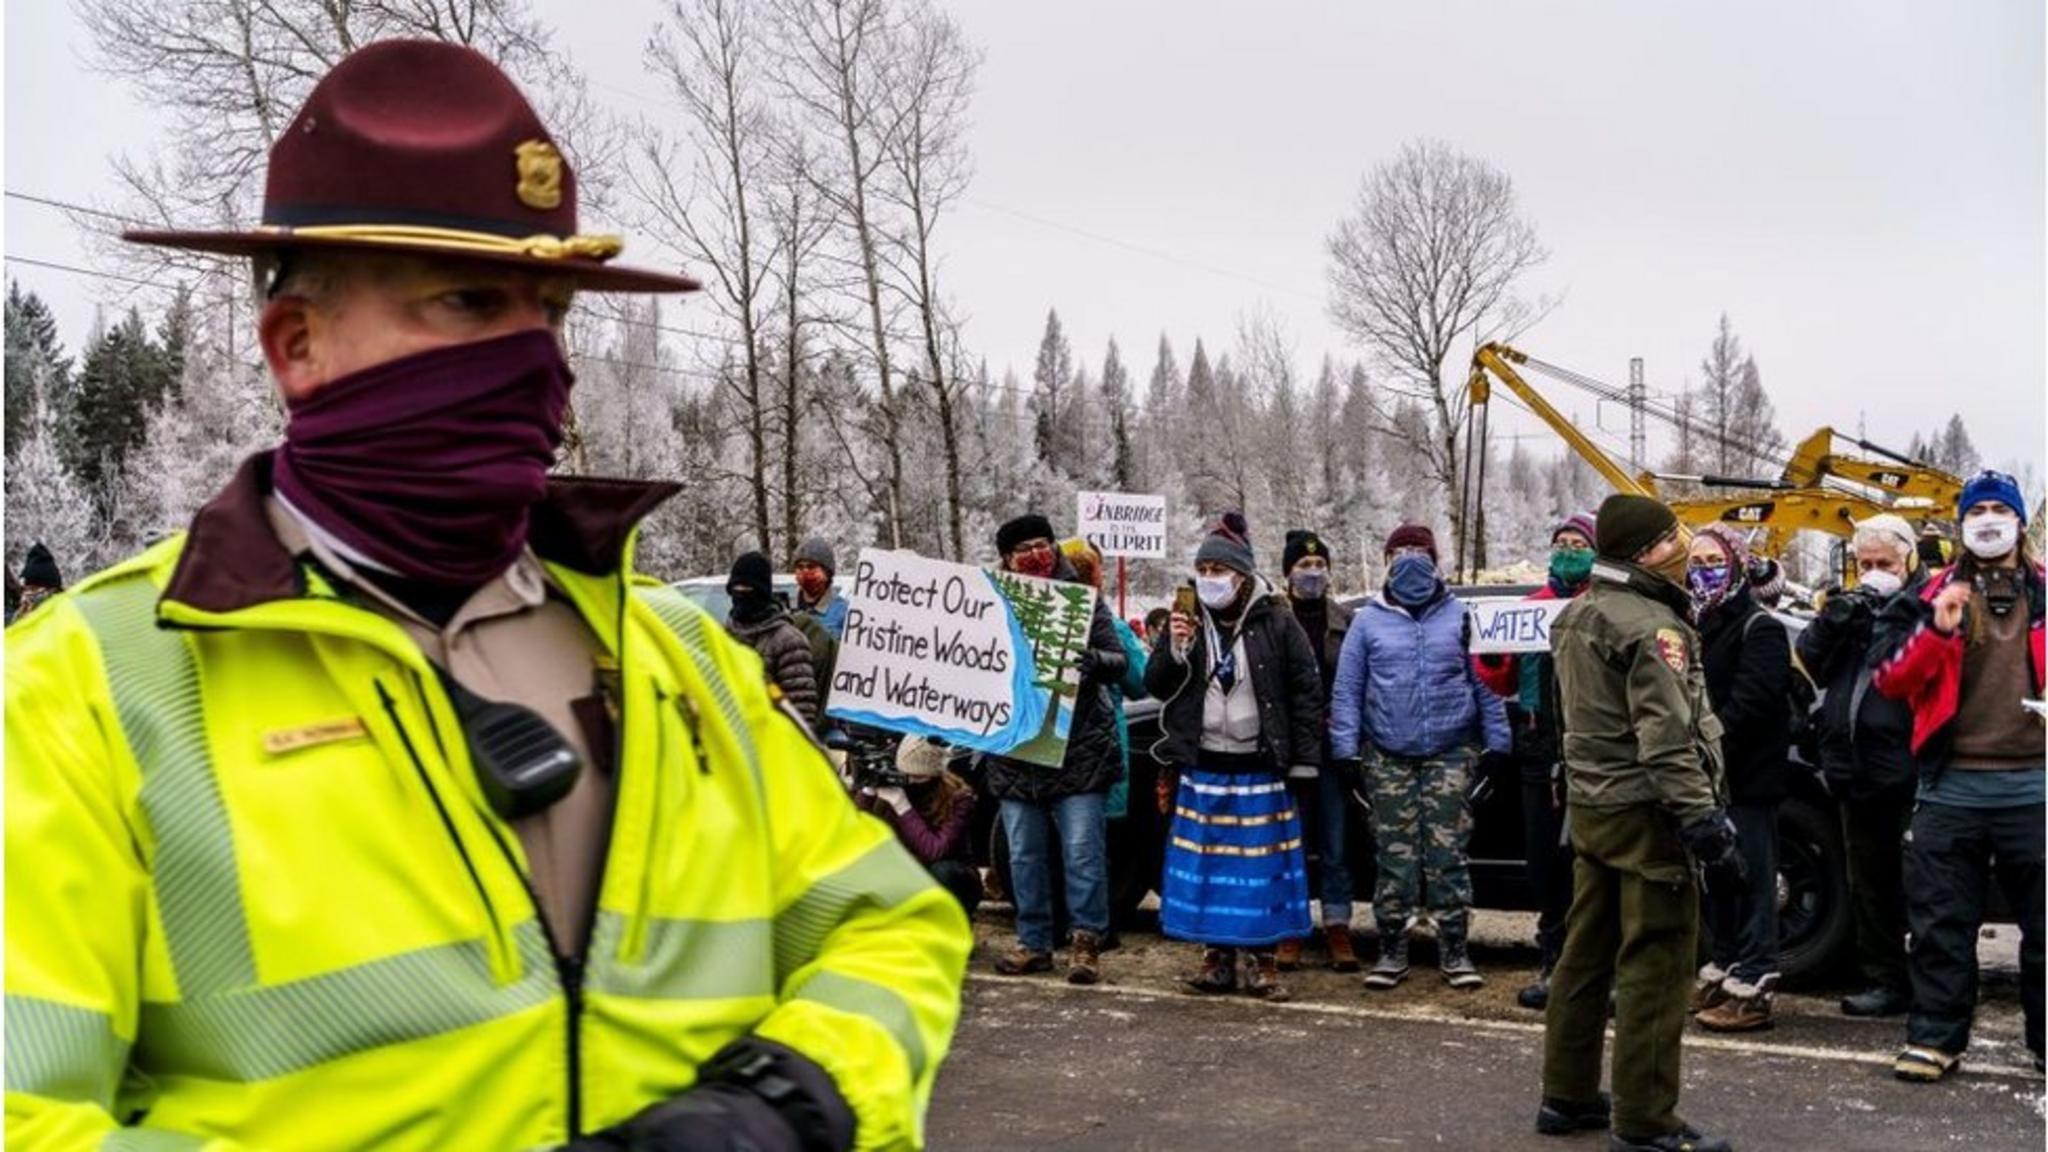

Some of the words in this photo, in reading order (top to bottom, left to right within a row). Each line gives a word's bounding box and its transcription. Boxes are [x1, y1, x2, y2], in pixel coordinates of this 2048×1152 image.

[1738, 507, 1762, 521] CAT
[853, 562, 937, 609] Protect
[943, 576, 994, 620] Our
[844, 609, 928, 660] Pristine
[934, 626, 1008, 672] Woods
[833, 665, 878, 698] and
[885, 667, 1011, 736] Waterways
